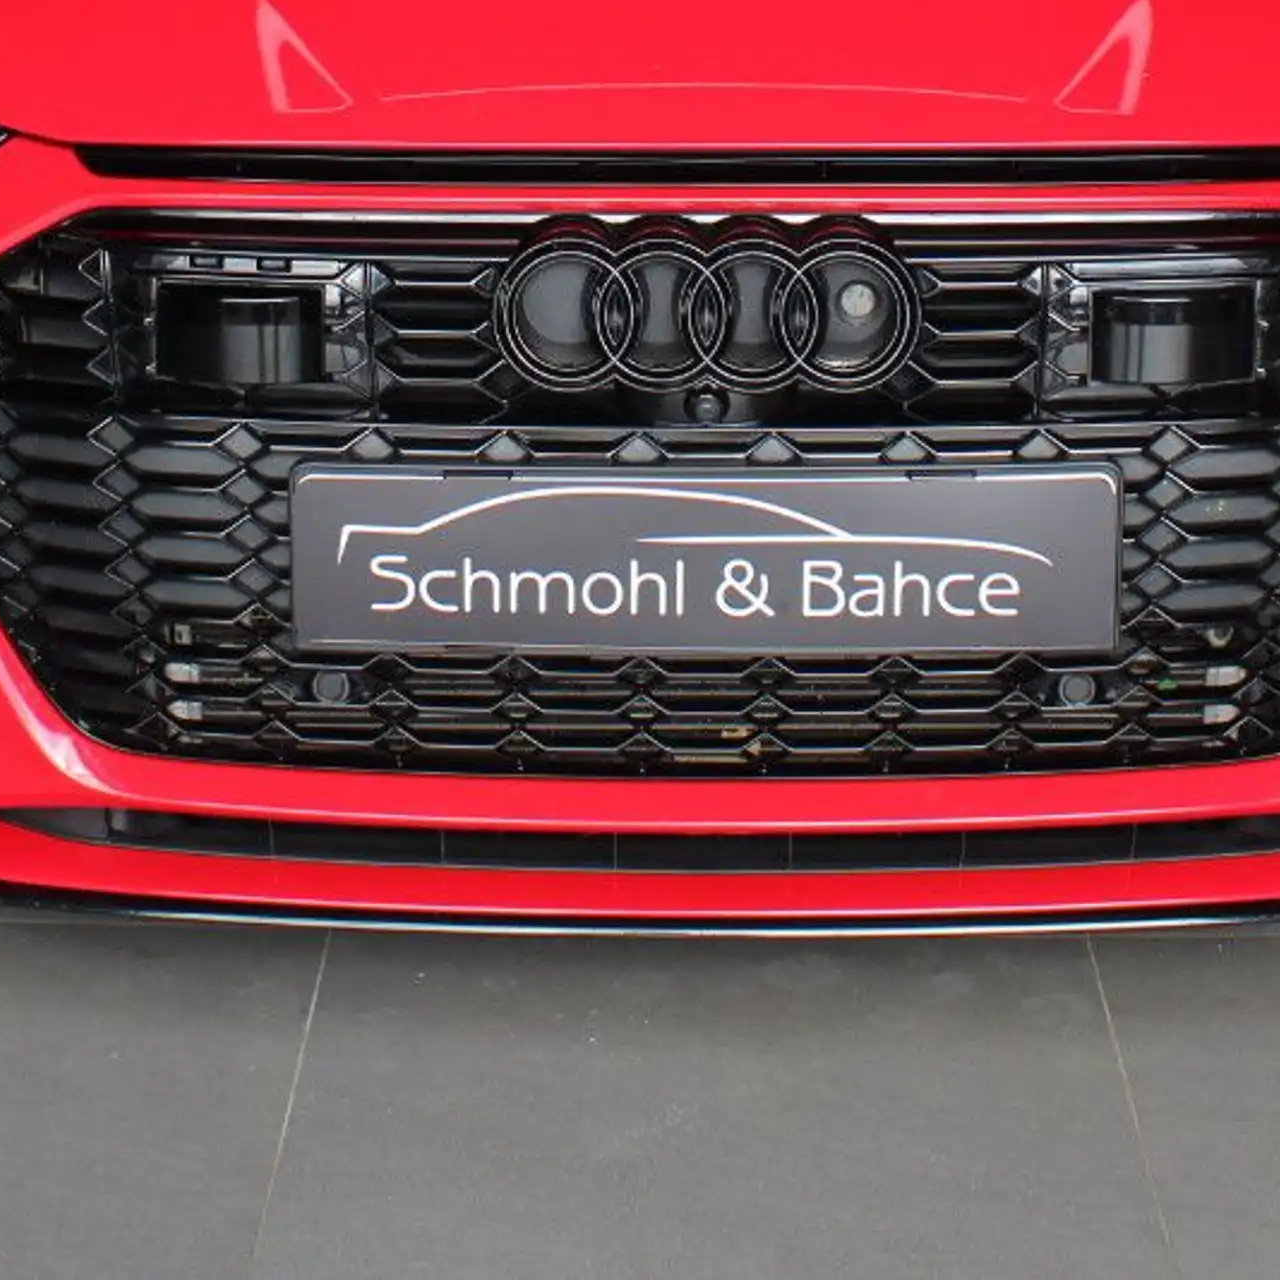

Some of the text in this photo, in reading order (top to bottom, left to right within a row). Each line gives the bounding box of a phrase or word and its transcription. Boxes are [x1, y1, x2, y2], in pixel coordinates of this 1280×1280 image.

[369, 554, 1021, 618] Schmohl & Bahce
